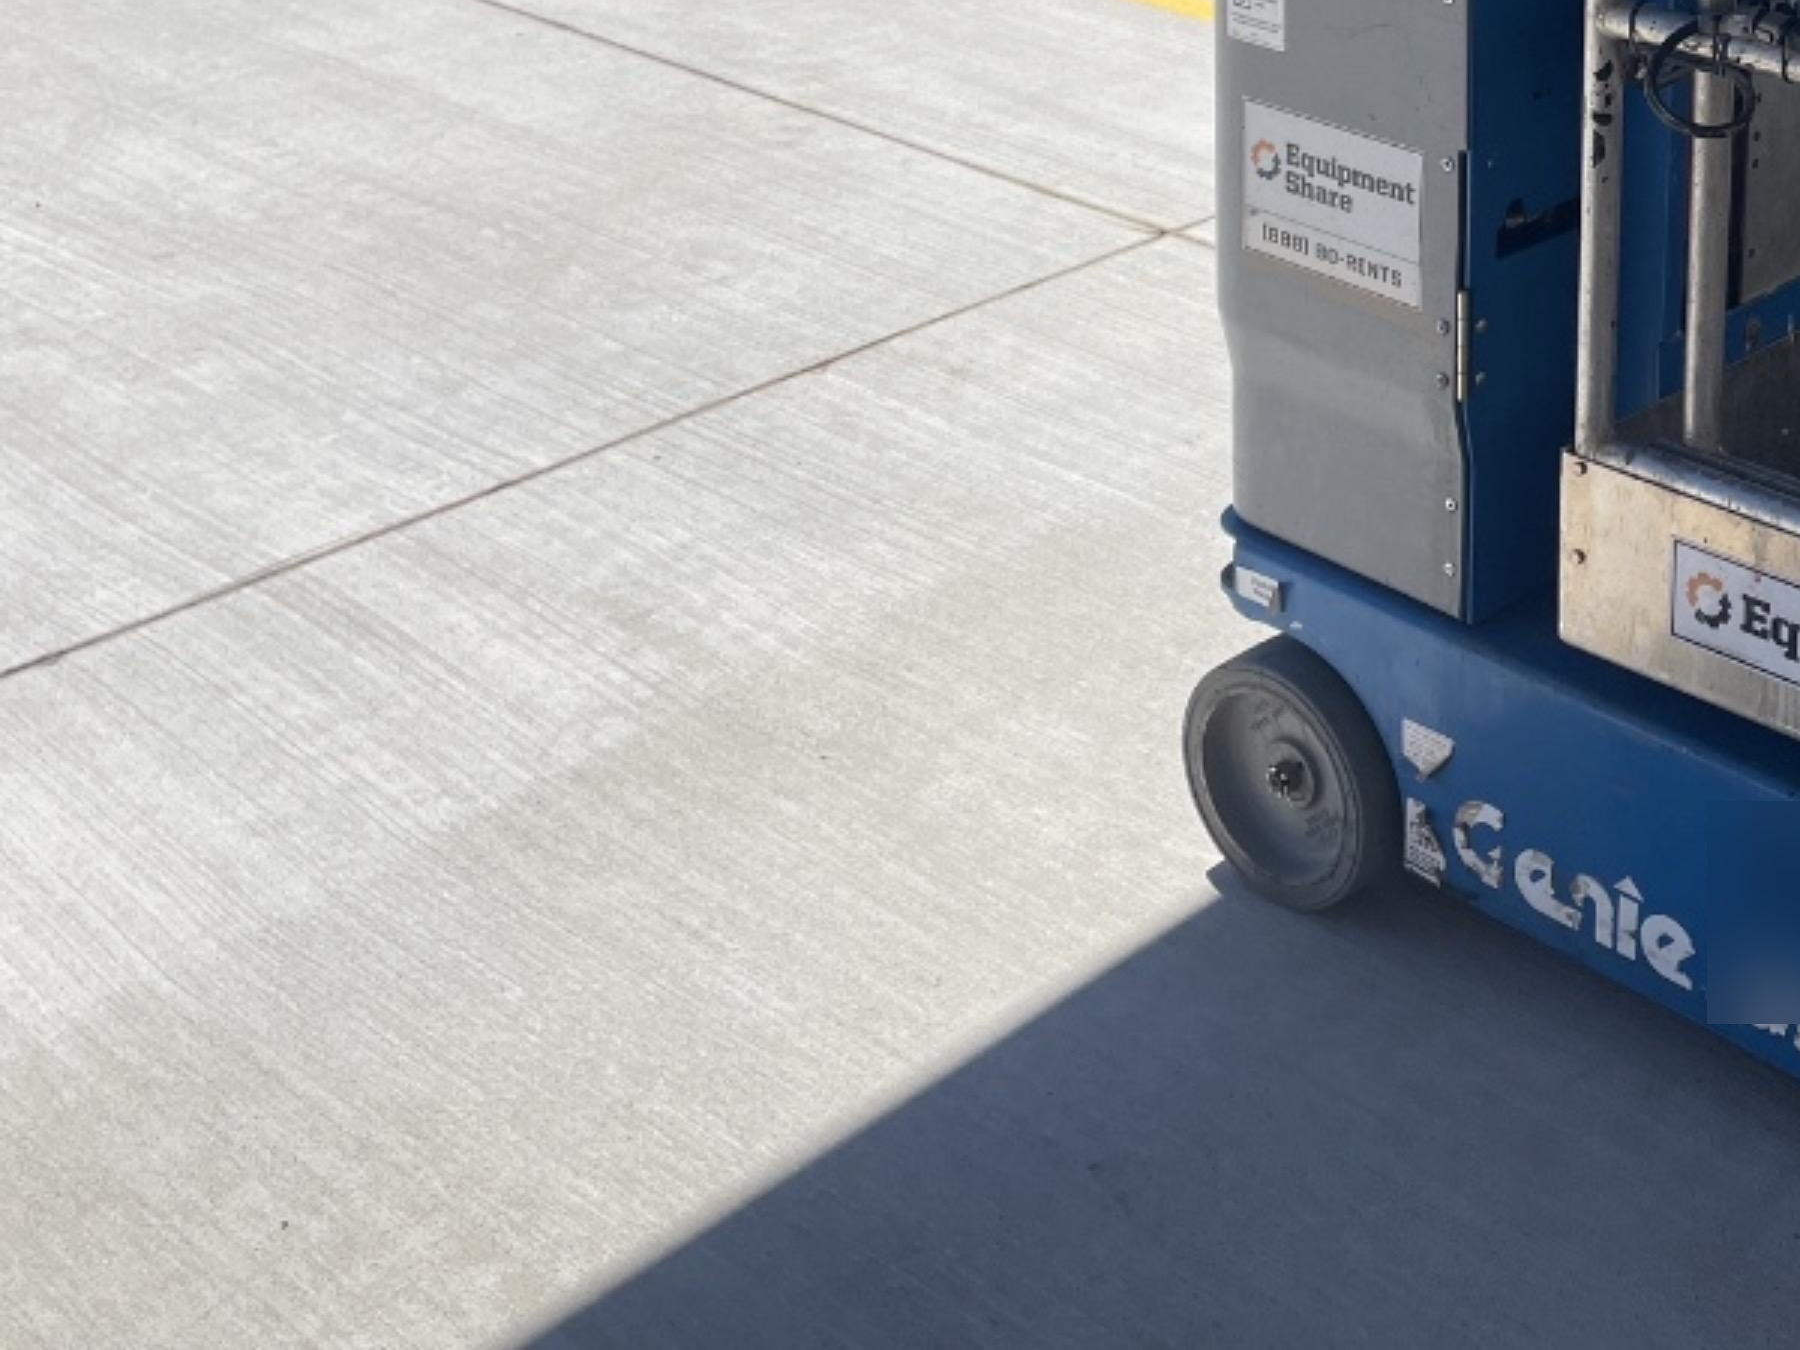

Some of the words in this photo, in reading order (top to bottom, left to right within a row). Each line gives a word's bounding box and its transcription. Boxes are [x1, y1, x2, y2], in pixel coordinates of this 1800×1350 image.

[1286, 143, 1416, 205] Equipment
[1286, 171, 1354, 213] Share
[1452, 799, 1697, 991] Genie
